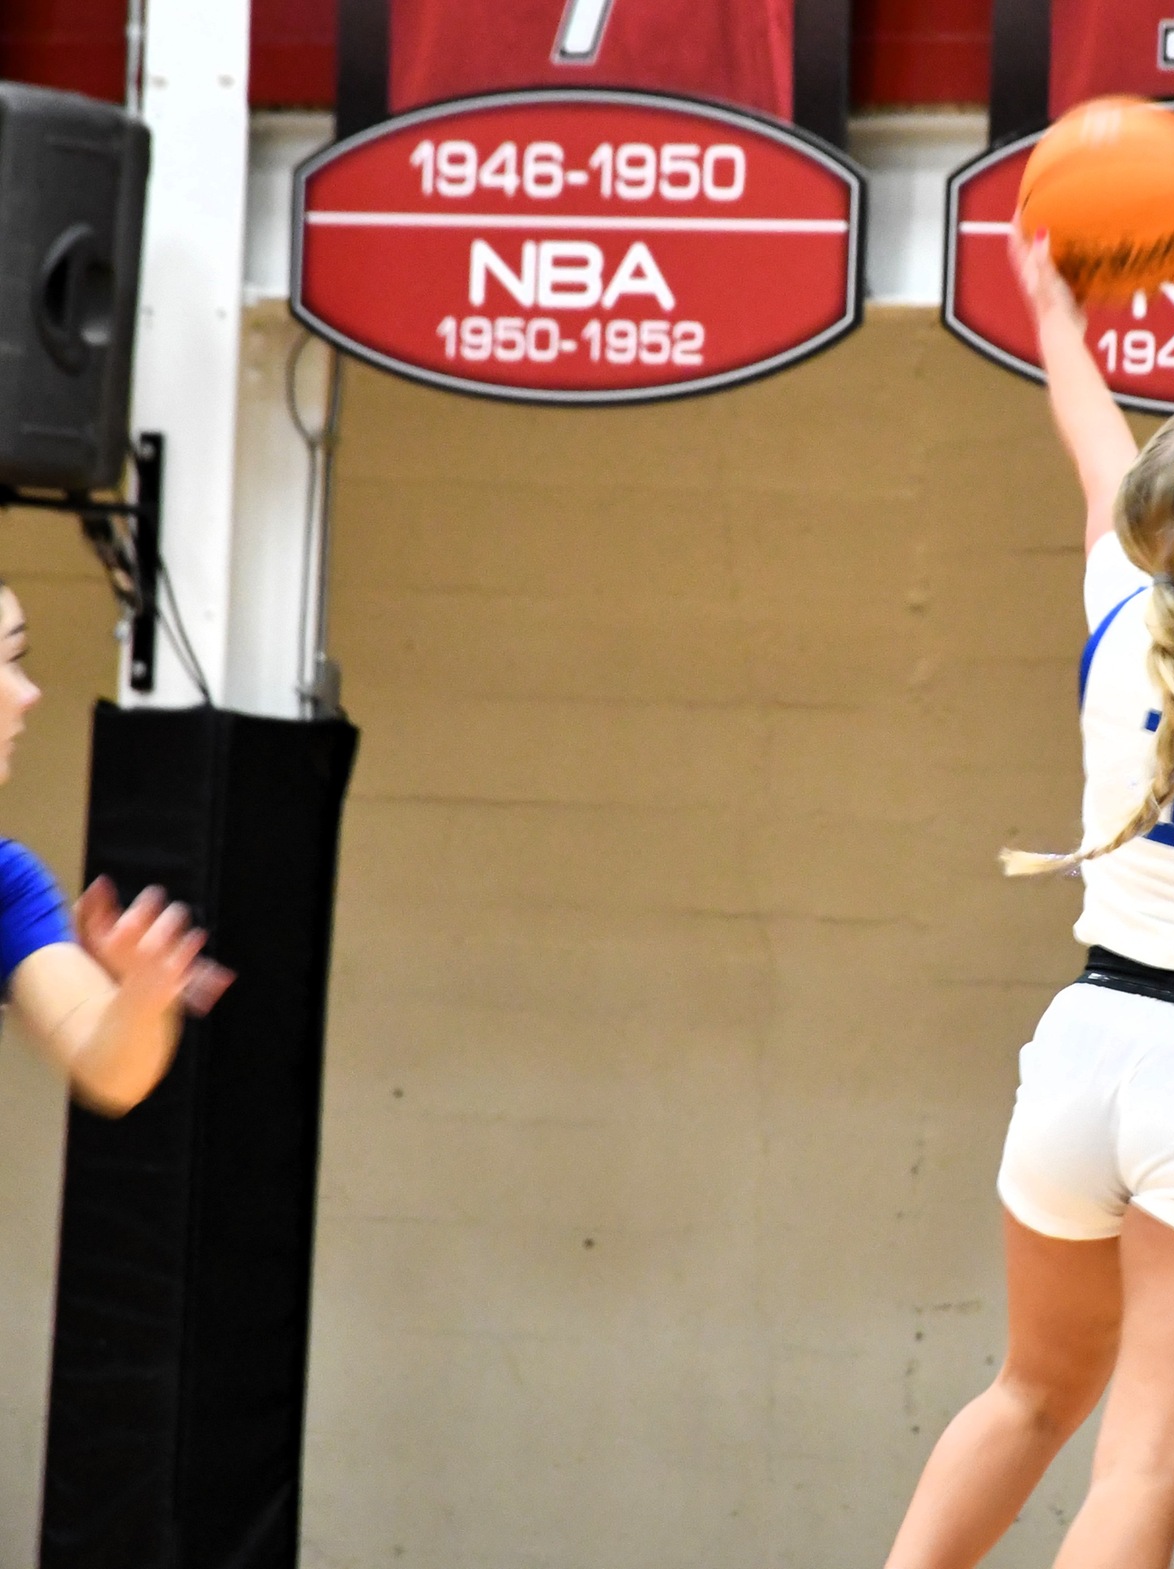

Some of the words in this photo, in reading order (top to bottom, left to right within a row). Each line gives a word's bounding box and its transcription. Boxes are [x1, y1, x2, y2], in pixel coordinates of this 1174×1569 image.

[410, 139, 747, 201] 1946-1950
[468, 238, 676, 311] NBA
[436, 315, 706, 366] 1950-1952
